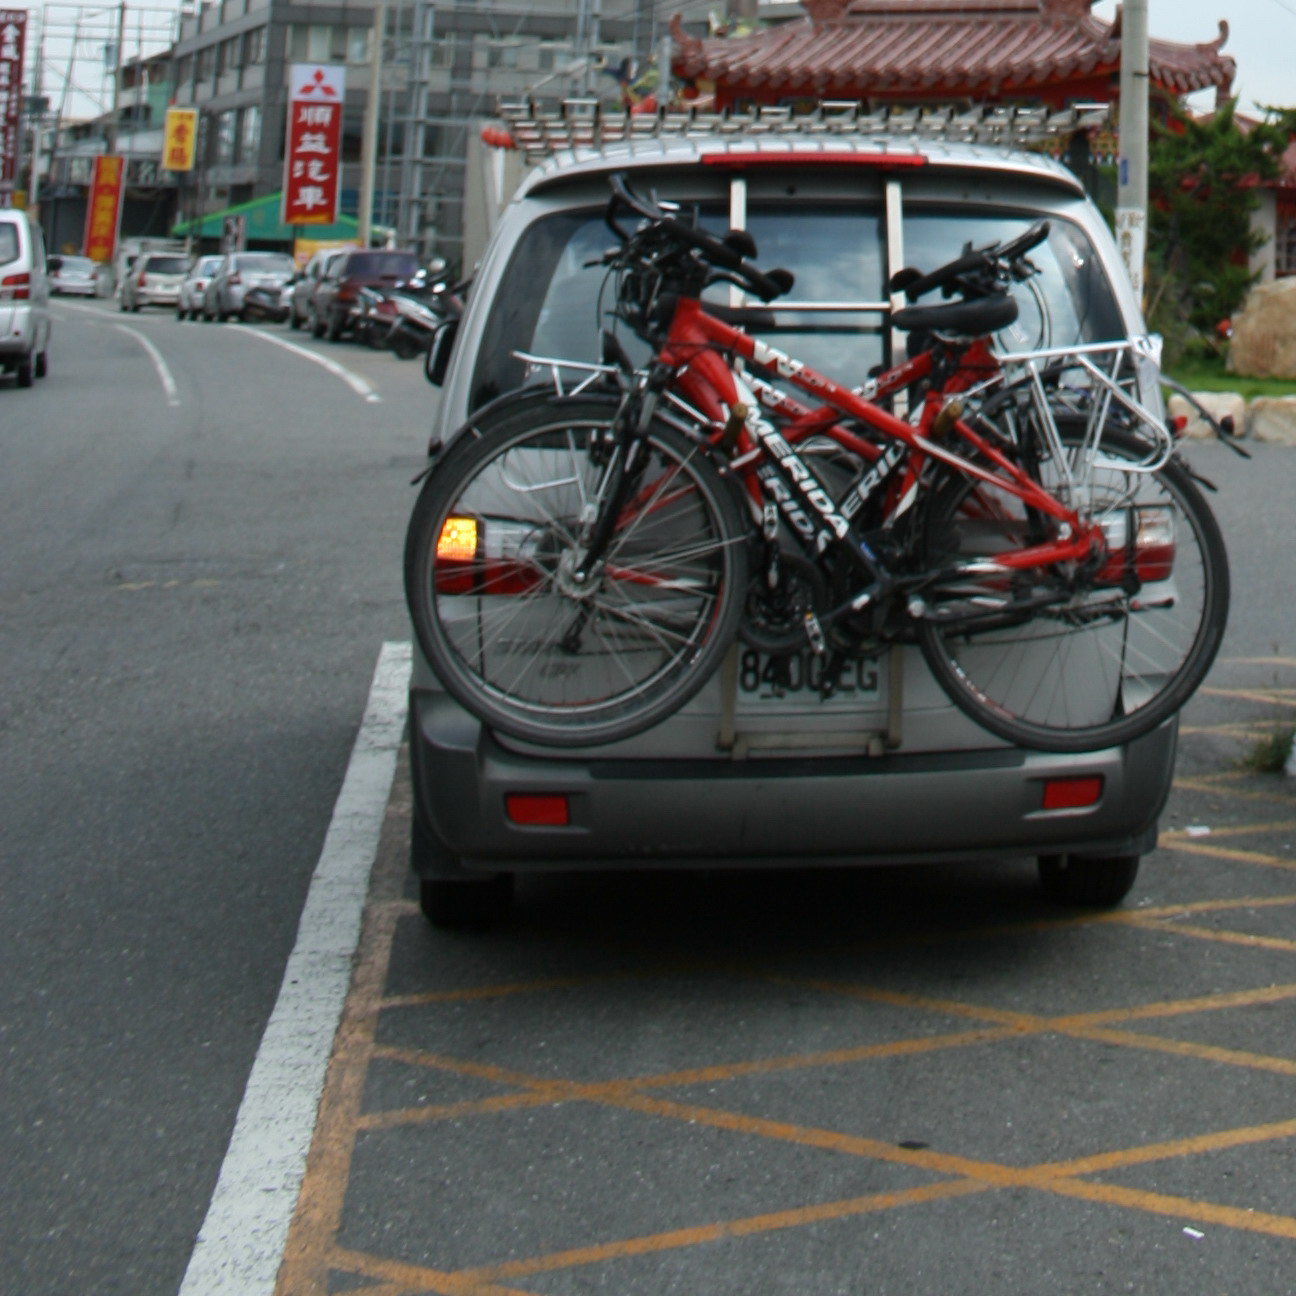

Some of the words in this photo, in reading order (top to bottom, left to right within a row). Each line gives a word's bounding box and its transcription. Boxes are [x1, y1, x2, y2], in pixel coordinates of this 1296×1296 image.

[292, 104, 335, 211] 順益汽車
[745, 405, 850, 539] MERIDA
[840, 439, 906, 520] ERID
